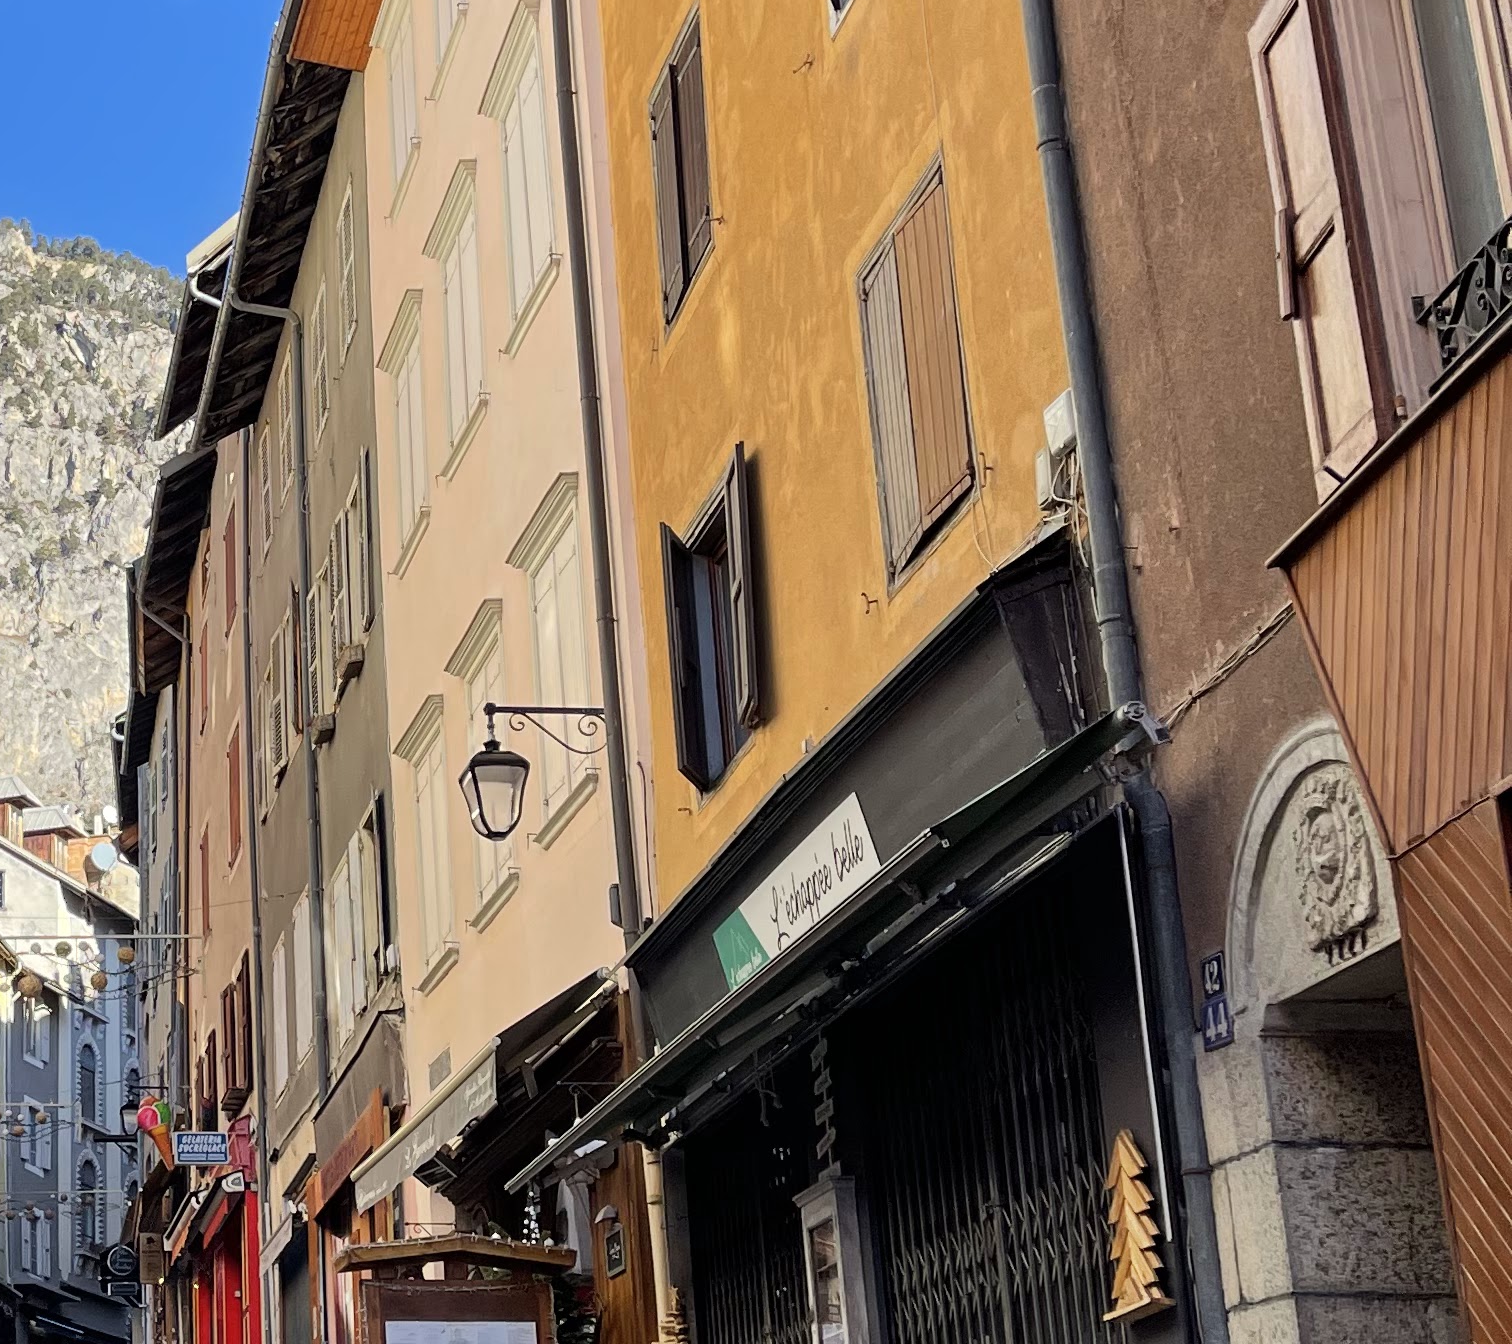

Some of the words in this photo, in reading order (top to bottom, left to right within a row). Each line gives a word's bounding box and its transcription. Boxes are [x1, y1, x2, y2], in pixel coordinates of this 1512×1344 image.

[830, 818, 864, 883] belle
[1204, 959, 1221, 995] 42
[1206, 1001, 1229, 1043] 44
